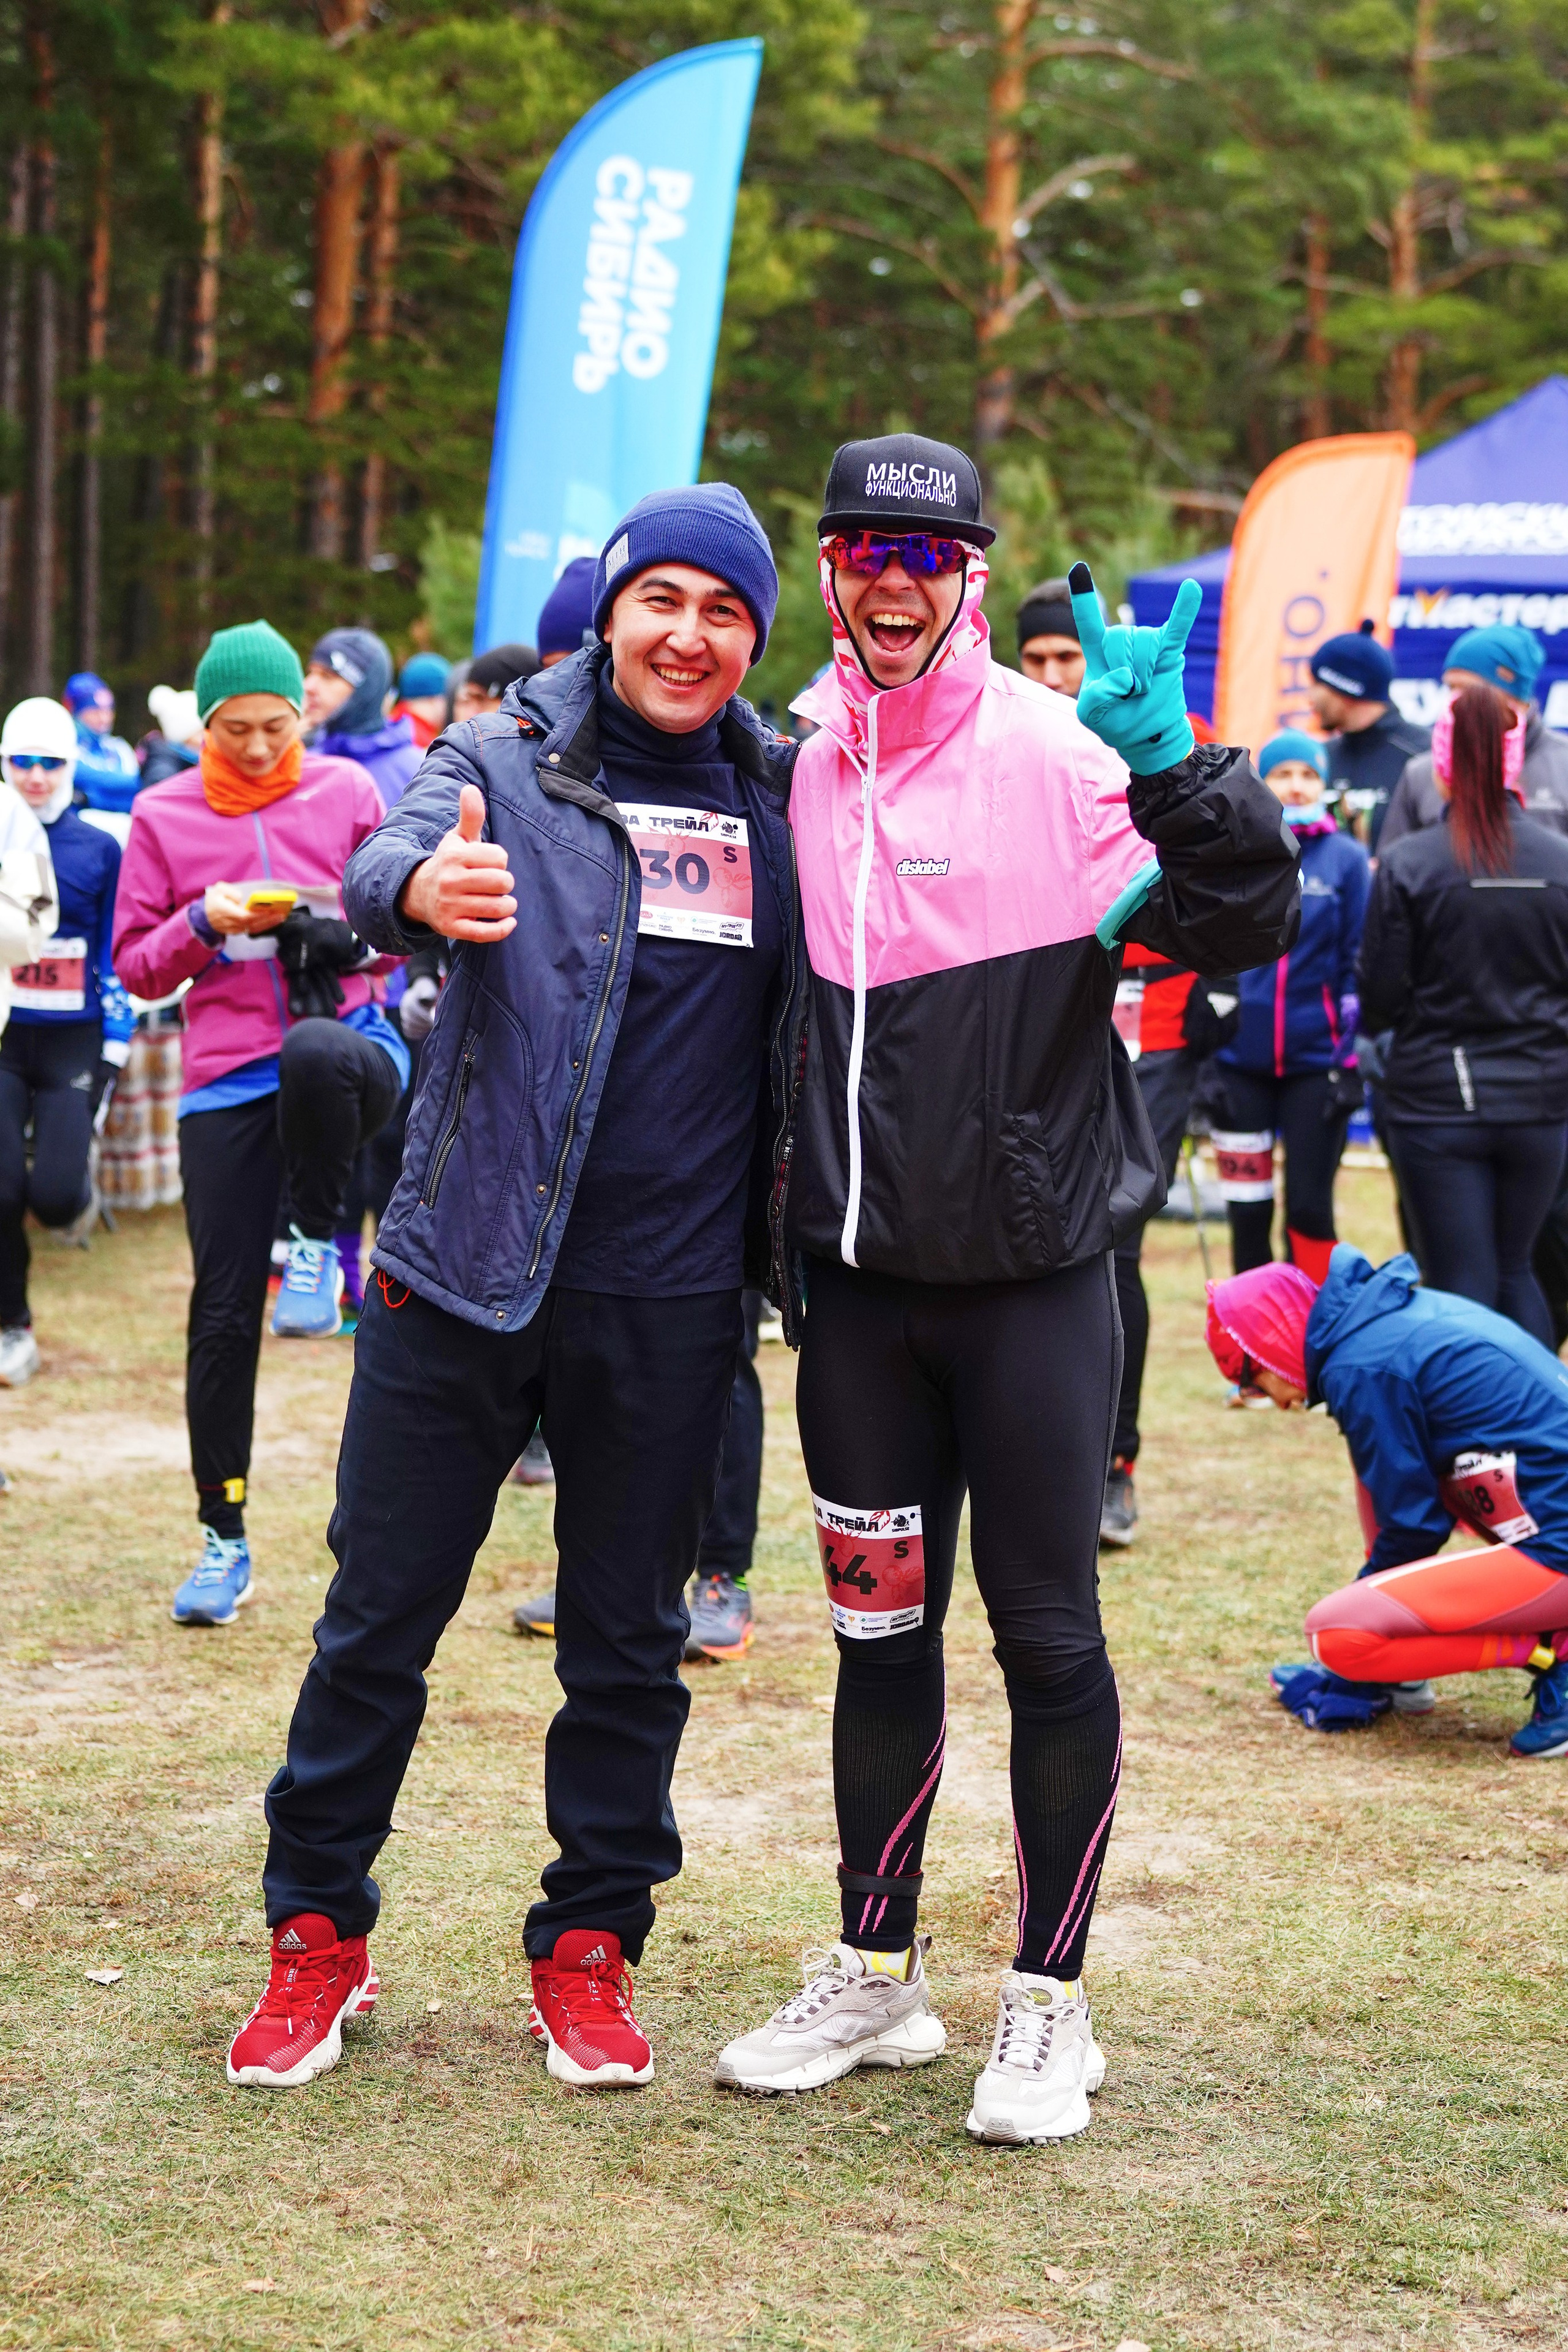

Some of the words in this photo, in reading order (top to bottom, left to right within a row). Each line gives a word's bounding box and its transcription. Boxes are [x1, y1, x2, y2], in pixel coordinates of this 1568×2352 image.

[572, 154, 645, 394] СИБИРЬ
[620, 167, 694, 380] РАДИО
[867, 462, 957, 491] МЫСЛИ
[865, 480, 957, 507] ФУНКЦИОНАЛЬНО
[649, 816, 709, 832] ТРЕЙЛ
[723, 846, 738, 863] S
[639, 848, 710, 895] 30
[896, 858, 950, 876] dislabel
[827, 1512, 879, 1532] ТРЕЙЛ
[894, 1540, 909, 1559] S
[823, 1544, 878, 1595] 44
[278, 1941, 307, 1950] adidas
